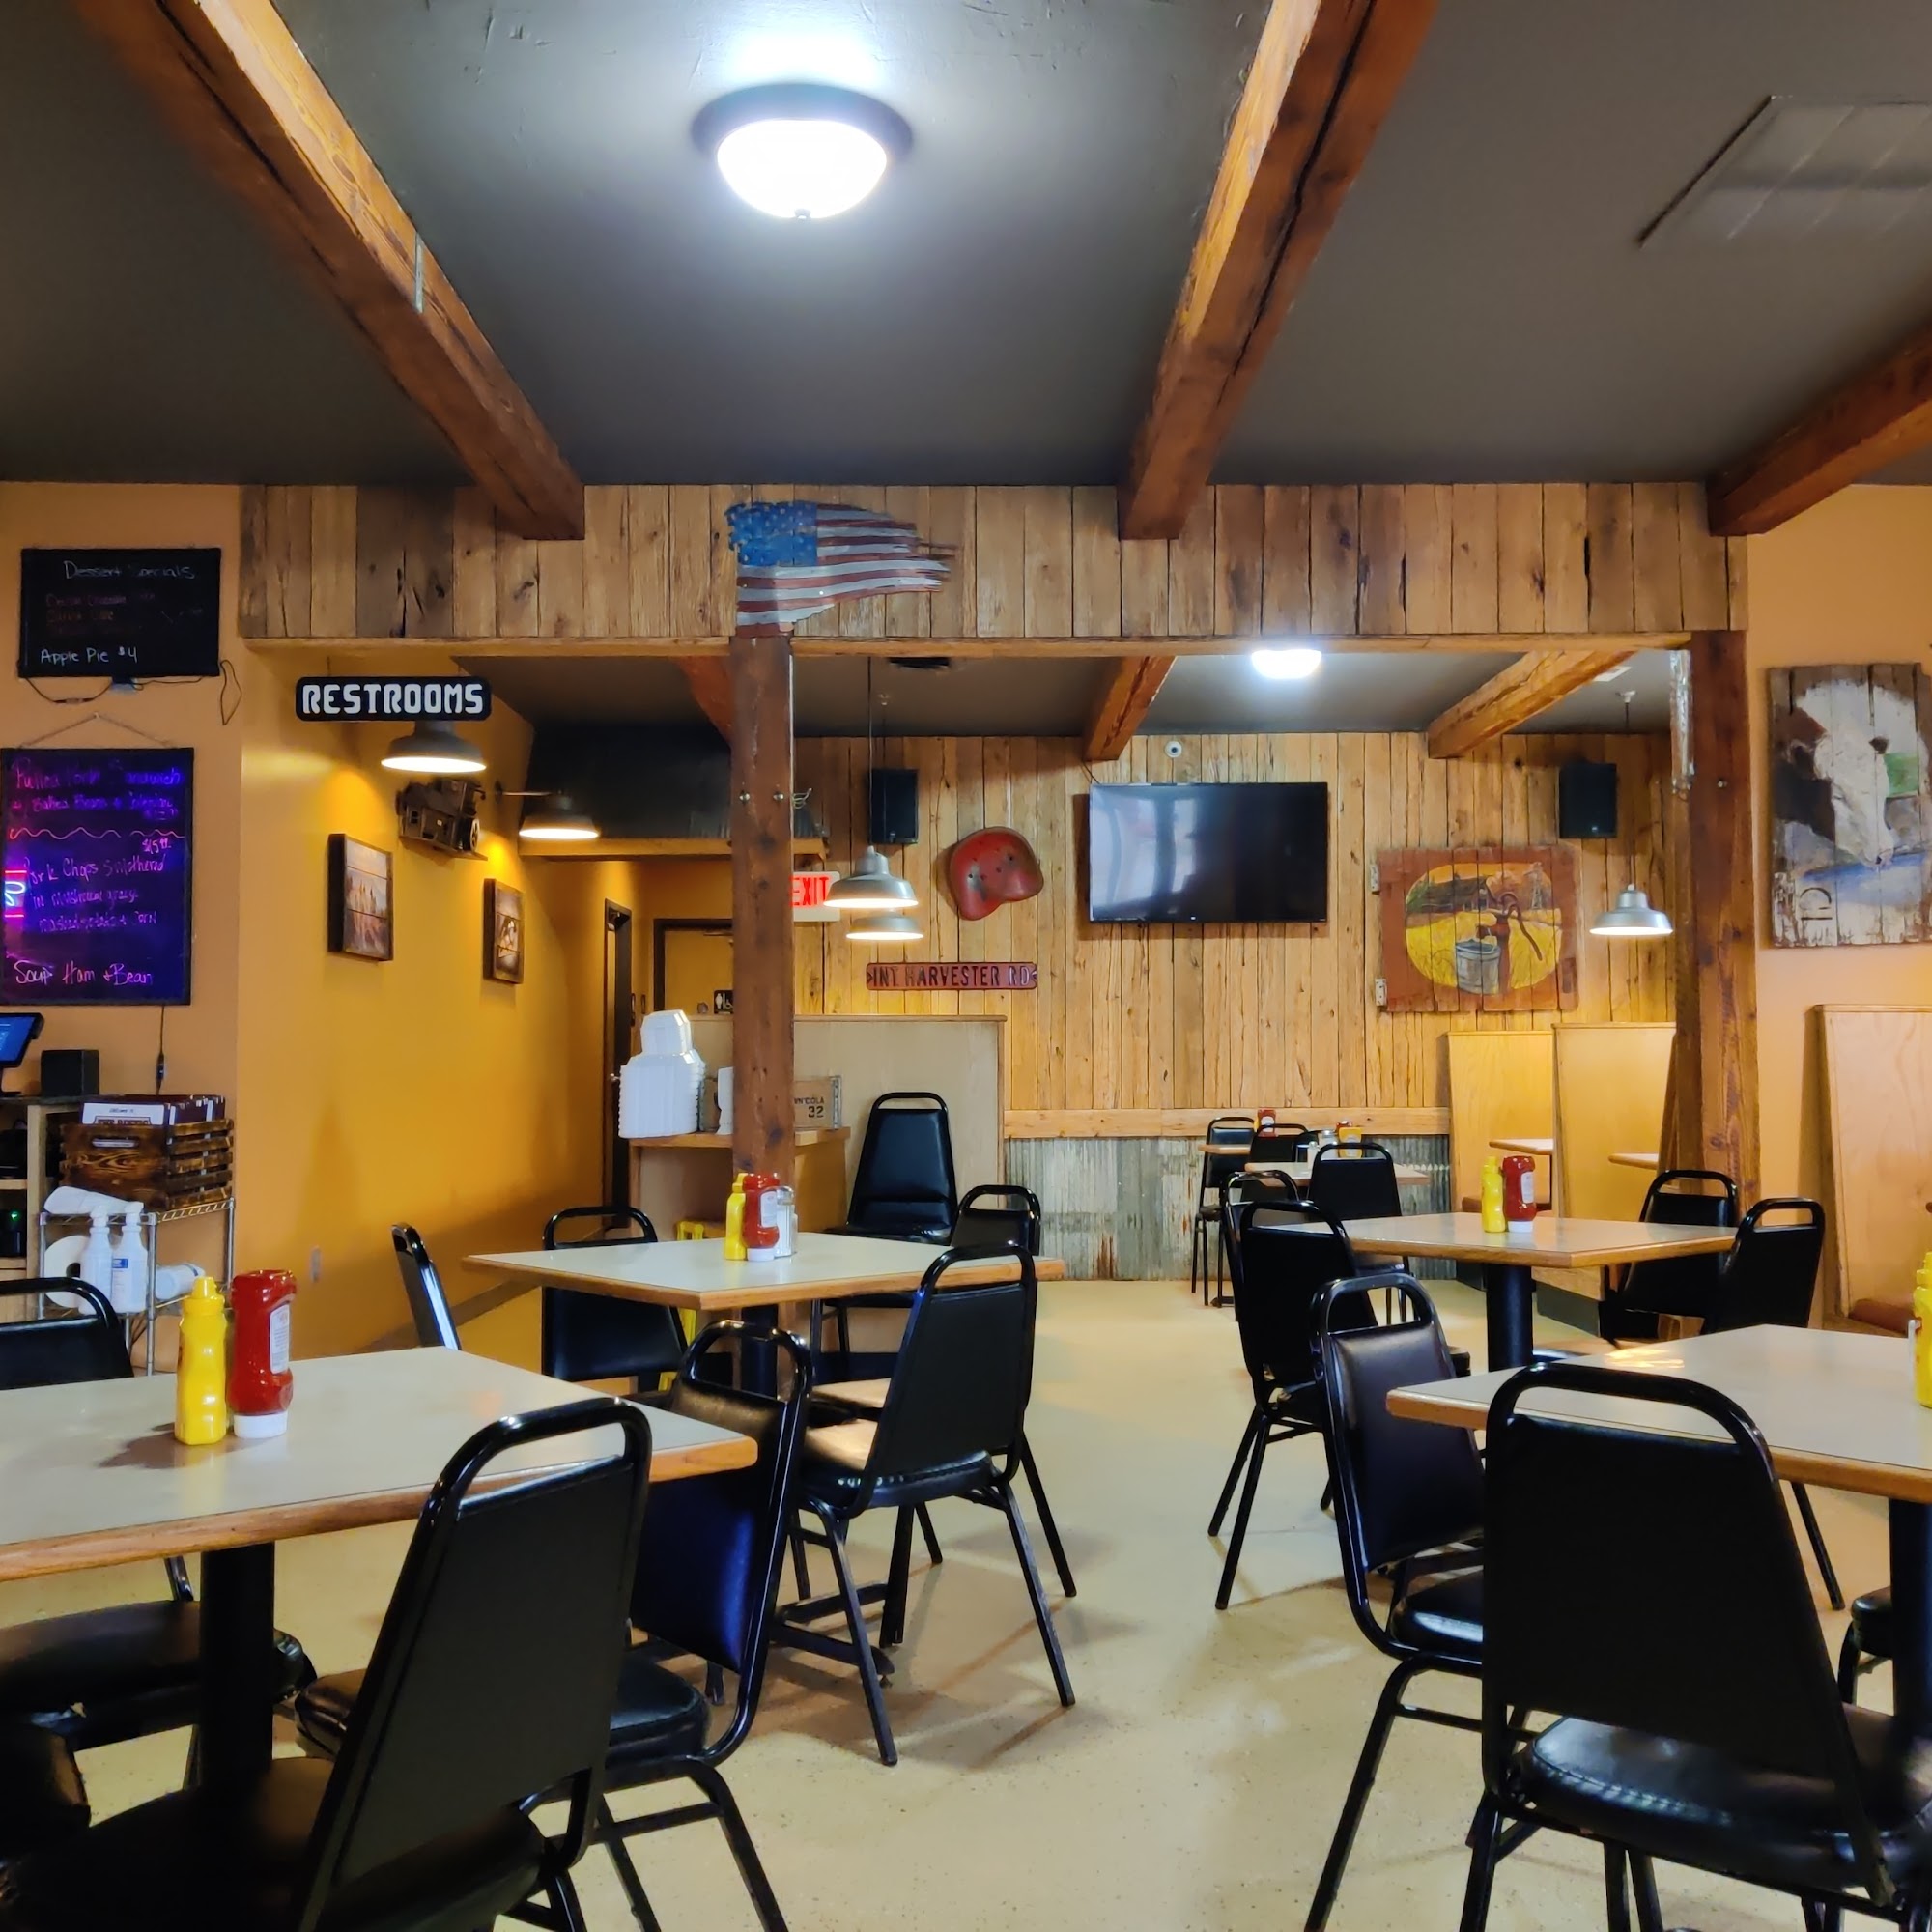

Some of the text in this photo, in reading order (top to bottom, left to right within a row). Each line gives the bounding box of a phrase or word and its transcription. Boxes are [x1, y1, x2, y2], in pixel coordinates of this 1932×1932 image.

[63, 559, 196, 581] Dessert pecials
[40, 645, 139, 667] Apple Pie $4
[302, 683, 483, 714] RESTROOMS
[63, 856, 99, 882] Chops
[789, 875, 830, 906] EXIT
[14, 959, 52, 985] Soup
[62, 959, 96, 985] Ham
[110, 962, 154, 986] Bean
[872, 965, 1030, 988] INT HARVESTER RD
[808, 1105, 824, 1119] 32
